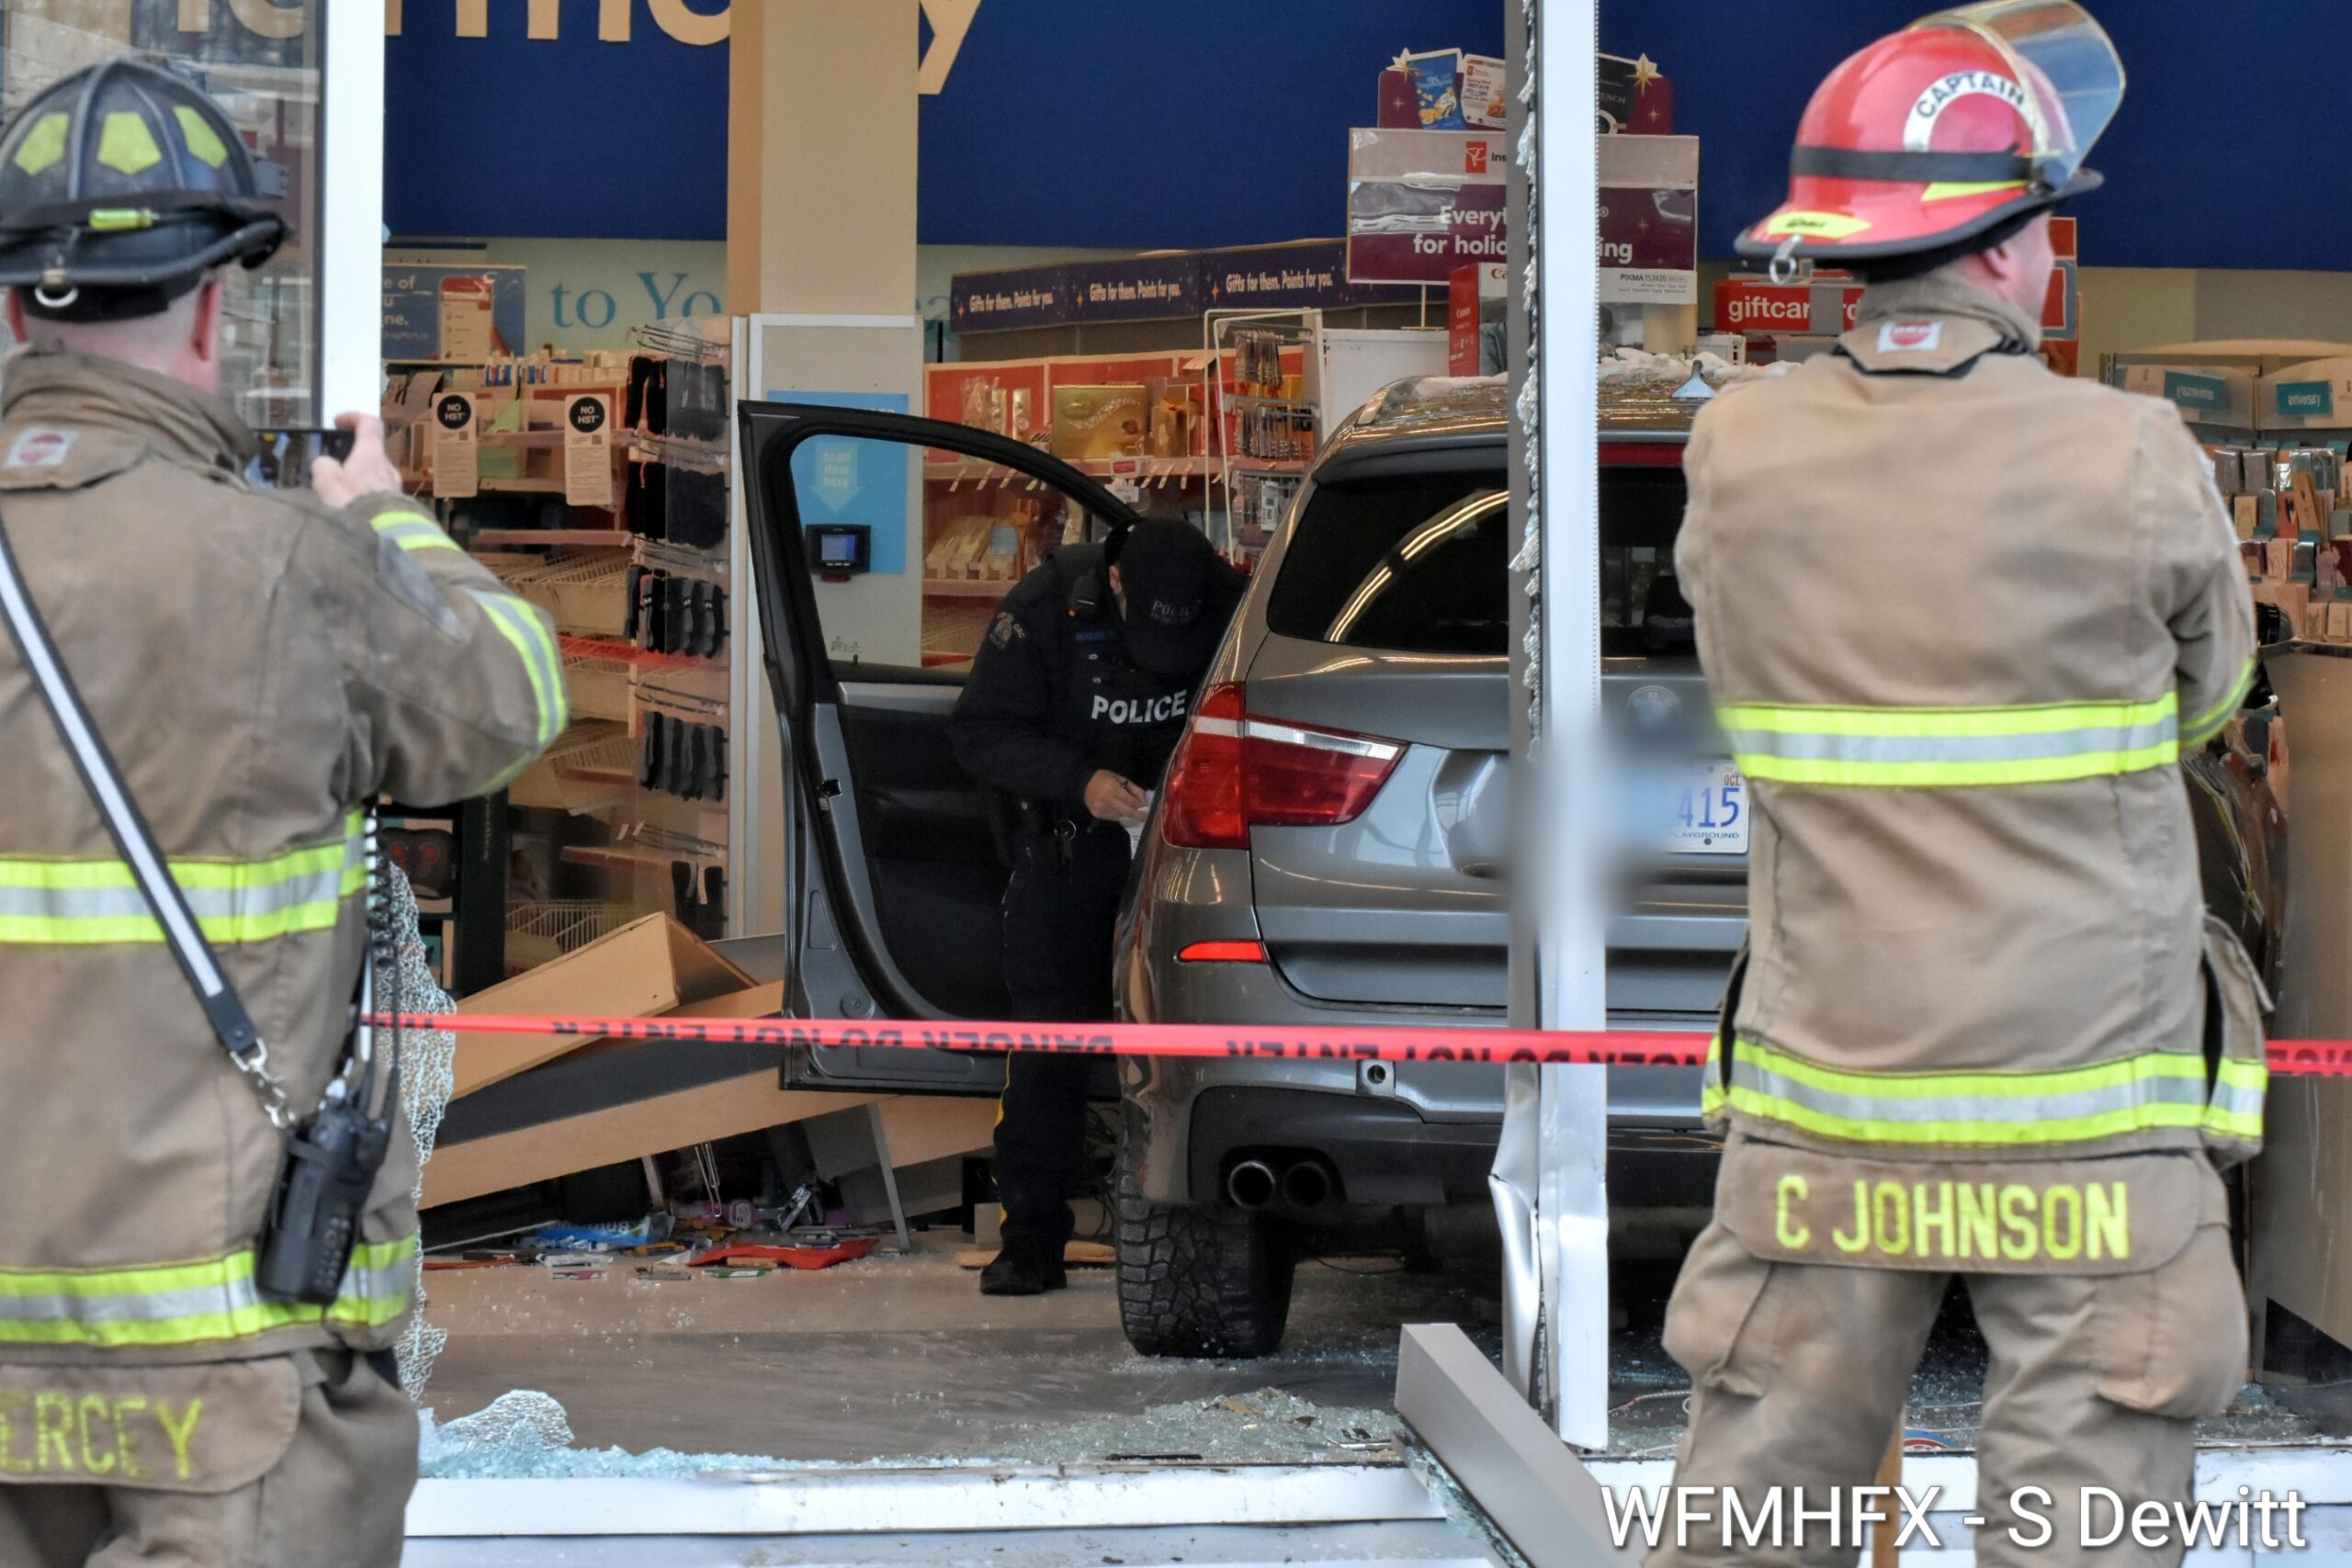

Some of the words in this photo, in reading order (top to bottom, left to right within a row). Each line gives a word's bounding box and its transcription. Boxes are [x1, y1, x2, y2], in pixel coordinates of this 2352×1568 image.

[1917, 72, 2025, 118] CAPTAIN
[1413, 233, 1447, 255] for
[398, 275, 415, 289] of
[1090, 283, 1106, 302] Gifts
[1108, 282, 1118, 301] for
[1118, 281, 1136, 299] them.
[1137, 280, 1157, 299] Points
[1157, 279, 1167, 298] for
[1226, 273, 1245, 294] Gifts
[1247, 272, 1258, 292] for
[1260, 271, 1281, 291] them.
[1282, 269, 1305, 290] Points
[1306, 268, 1317, 288] for
[550, 280, 616, 329] to
[969, 295, 984, 313] Gifts
[985, 294, 995, 311] for
[996, 292, 1012, 310] them.
[1013, 290, 1032, 309] Points
[1032, 289, 1041, 307] for
[447, 403, 461, 412] NO
[580, 406, 595, 414] NO
[1091, 689, 1187, 724] POLICE
[1774, 1173, 1810, 1251] C
[1833, 1179, 2130, 1260] JOHNSON
